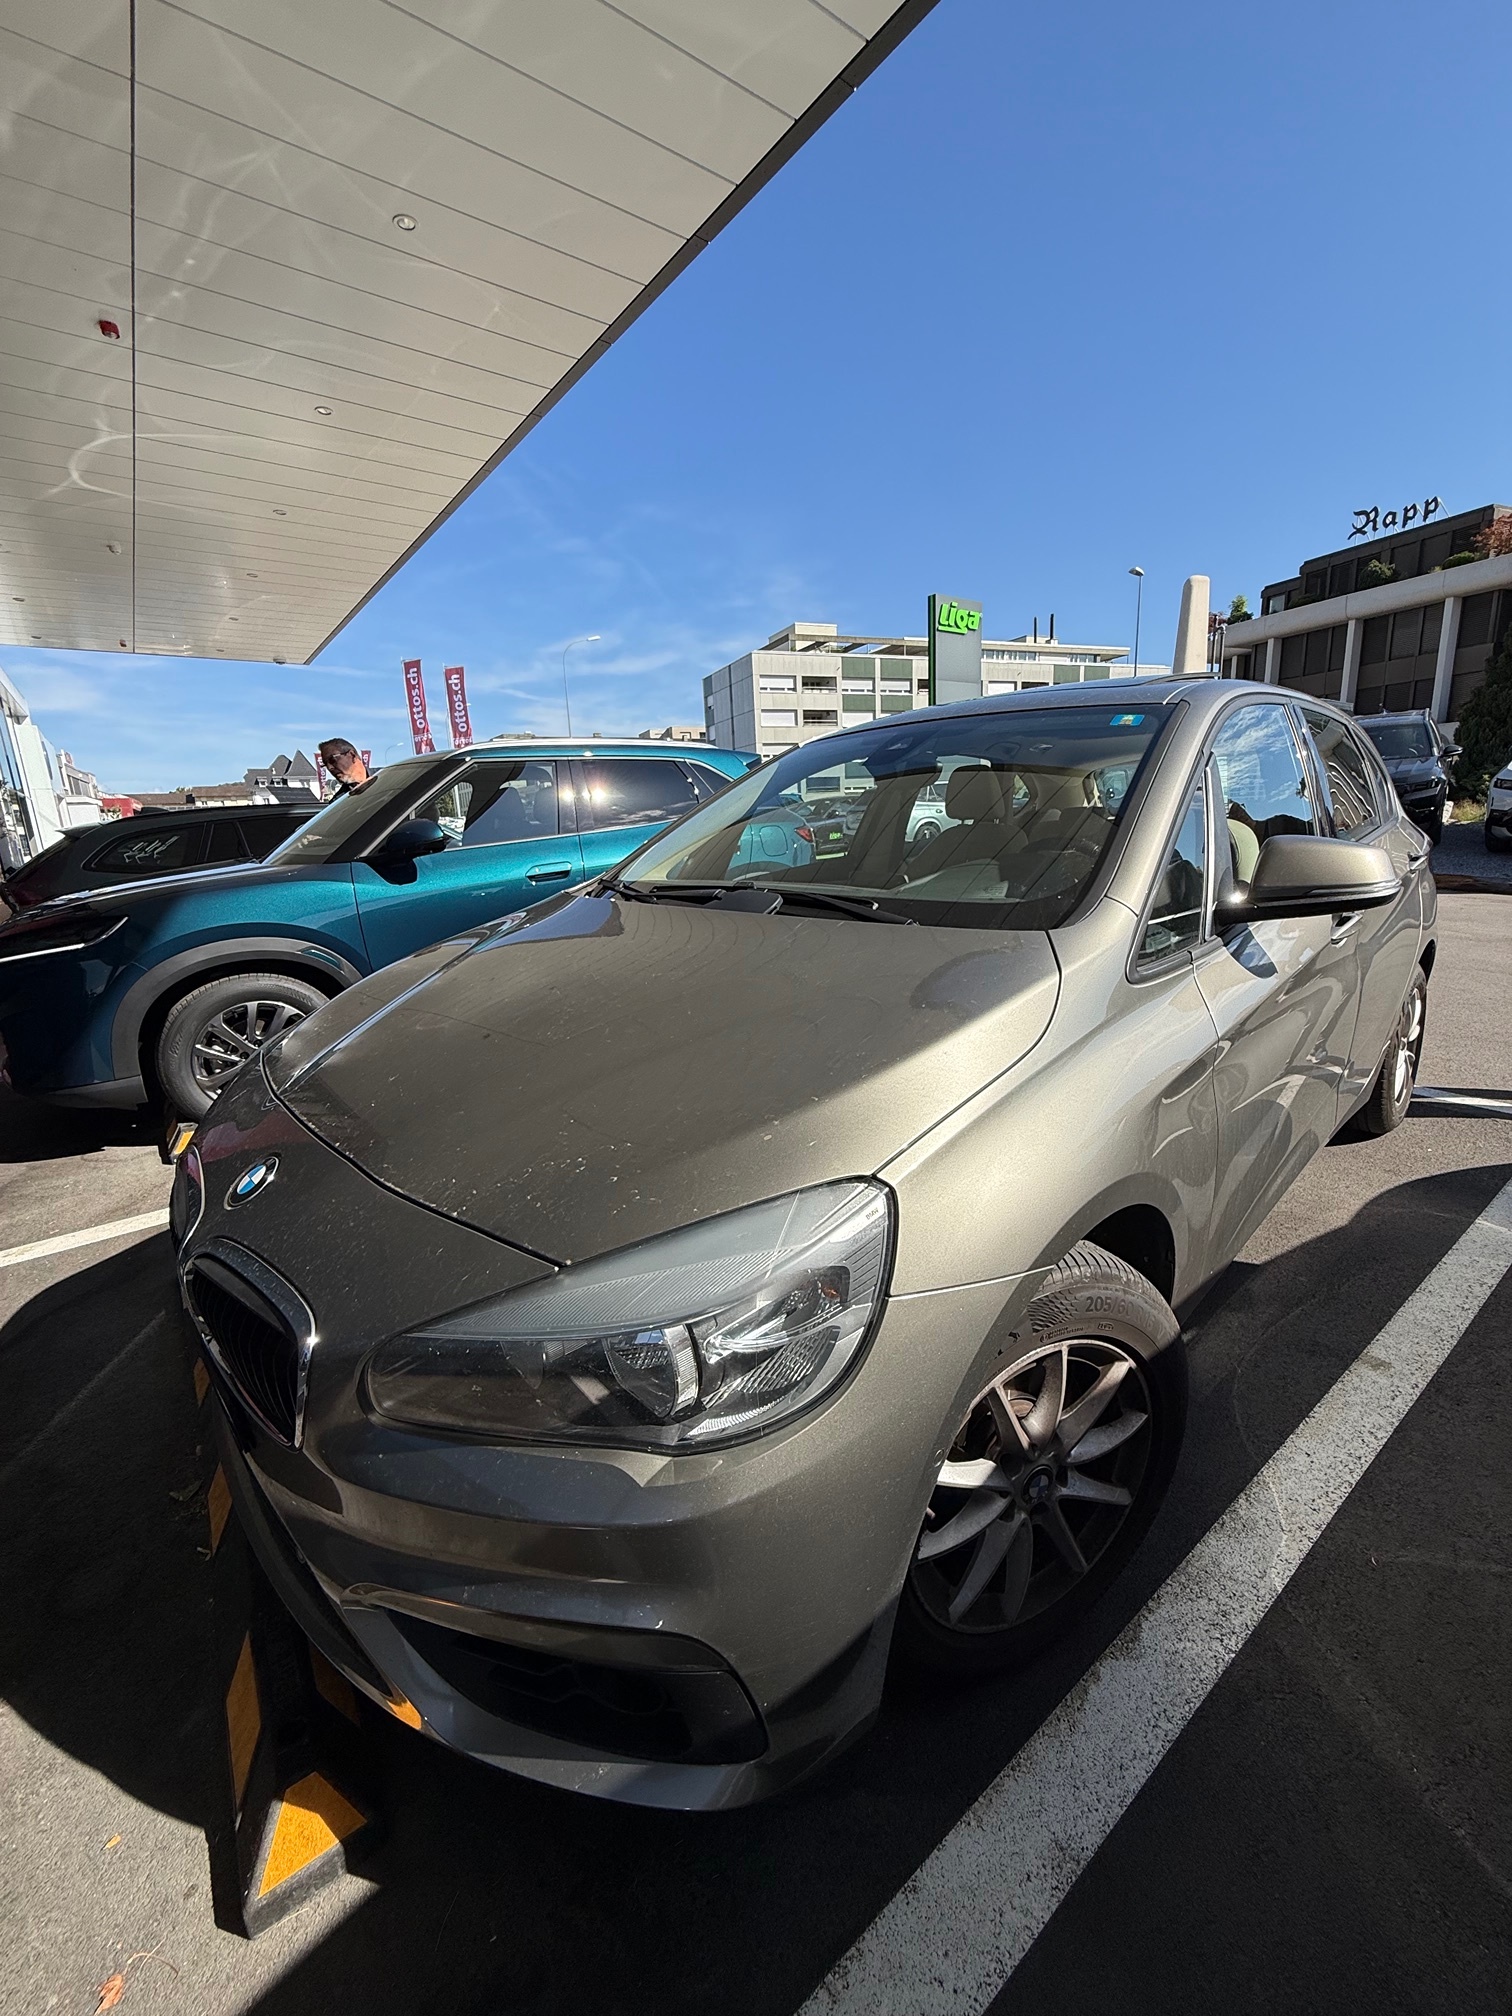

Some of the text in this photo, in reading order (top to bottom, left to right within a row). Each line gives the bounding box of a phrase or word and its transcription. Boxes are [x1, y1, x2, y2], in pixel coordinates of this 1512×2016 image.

[1347, 496, 1440, 540] Rapp
[938, 601, 981, 635] Liga
[407, 667, 425, 729] ottos.ch
[448, 673, 468, 732] ottos.ch
[865, 1207, 879, 1221] BMW
[1085, 1296, 1134, 1317] 205/60
